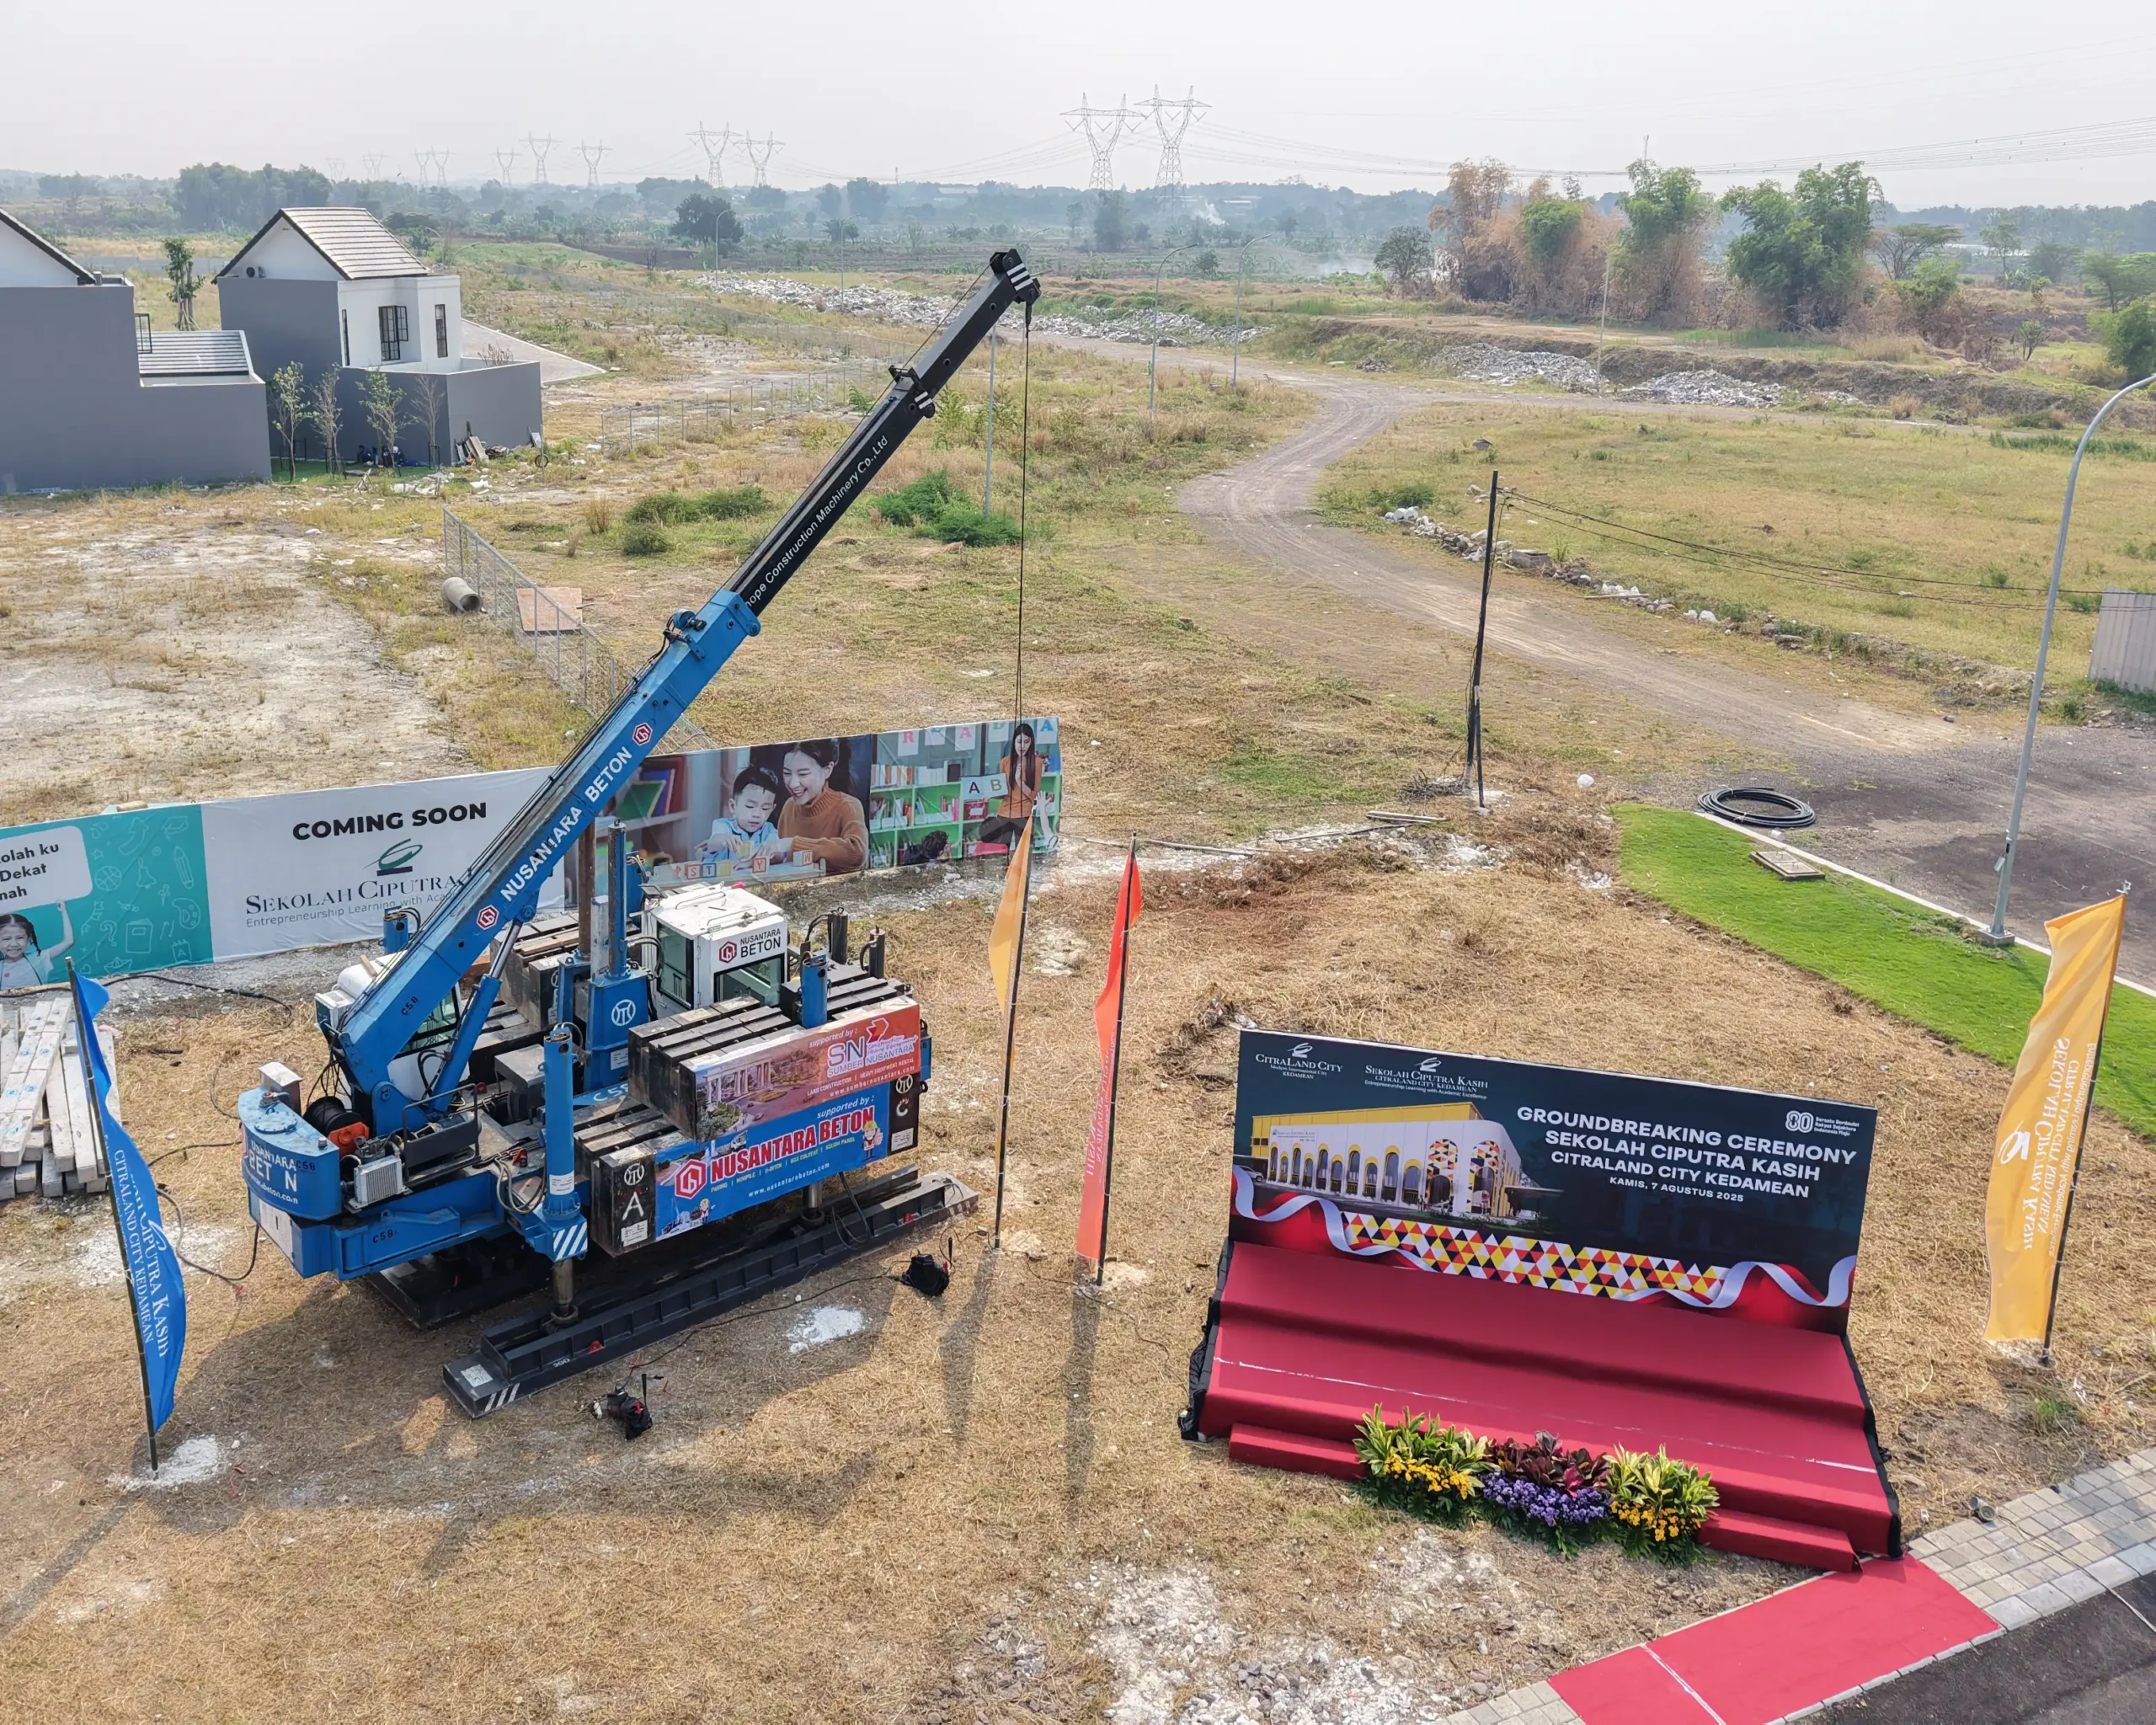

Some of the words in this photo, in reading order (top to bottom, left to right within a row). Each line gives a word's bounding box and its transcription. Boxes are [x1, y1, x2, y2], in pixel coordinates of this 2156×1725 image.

[765, 522, 818, 584] Construction
[816, 473, 859, 523] Machinery
[584, 746, 632, 803] BETON
[969, 781, 980, 794] A
[990, 778, 1002, 792] B
[292, 812, 403, 841] COMING
[412, 802, 487, 827] SOON
[40, 843, 59, 856] ku
[0, 863, 46, 882] Dekat
[246, 888, 352, 915] SEKOLAH
[358, 875, 459, 900] CIPUTRA
[246, 907, 344, 927] Entrepreneurship
[400, 895, 422, 906] with
[740, 928, 782, 945] NUSANTARA
[741, 937, 782, 958] BETON
[809, 1031, 844, 1048] supported
[845, 1028, 854, 1038] by
[828, 1036, 864, 1067] SN
[828, 1060, 863, 1077] SUMBER
[867, 1044, 914, 1065] NUSANTARA
[820, 1076, 852, 1092] CONSTRUCTION
[1364, 1079, 1405, 1090] Entrepreneurship
[1406, 1085, 1427, 1093] Learning
[1462, 1092, 1487, 1100] Excellence
[1374, 1075, 1417, 1086] CITRALAND
[1418, 1080, 1436, 1088] CITY
[1437, 1082, 1477, 1093] KEDAMEAN
[817, 1097, 858, 1119] supported
[860, 1097, 870, 1107] by
[1785, 1110, 1814, 1133] 80
[711, 1124, 816, 1184] NUSANTARA
[819, 1106, 874, 1144] BETON
[1517, 1106, 1722, 1146] GROUNDBREAKING
[1727, 1134, 1858, 1165] CEREMONY
[1545, 1130, 1646, 1156] SEKOLAH
[1651, 1144, 1746, 1171] CIPUTRA
[1752, 1157, 1821, 1181] KASIH
[114, 1149, 137, 1231] CITRALAND
[1550, 1151, 1654, 1176] CITRALAND
[1657, 1164, 1701, 1183] CITY
[1705, 1172, 1810, 1199] KEDAMEAN
[1609, 1177, 1648, 1189] KAMIS,
[1651, 1182, 1658, 1190] 7
[1661, 1183, 1714, 1198] AGUSTUS
[1716, 1191, 1744, 1203] 2025
[622, 1191, 644, 1221] A
[128, 1232, 144, 1265] CITY
[135, 1268, 153, 1343] KEDAMEAN
